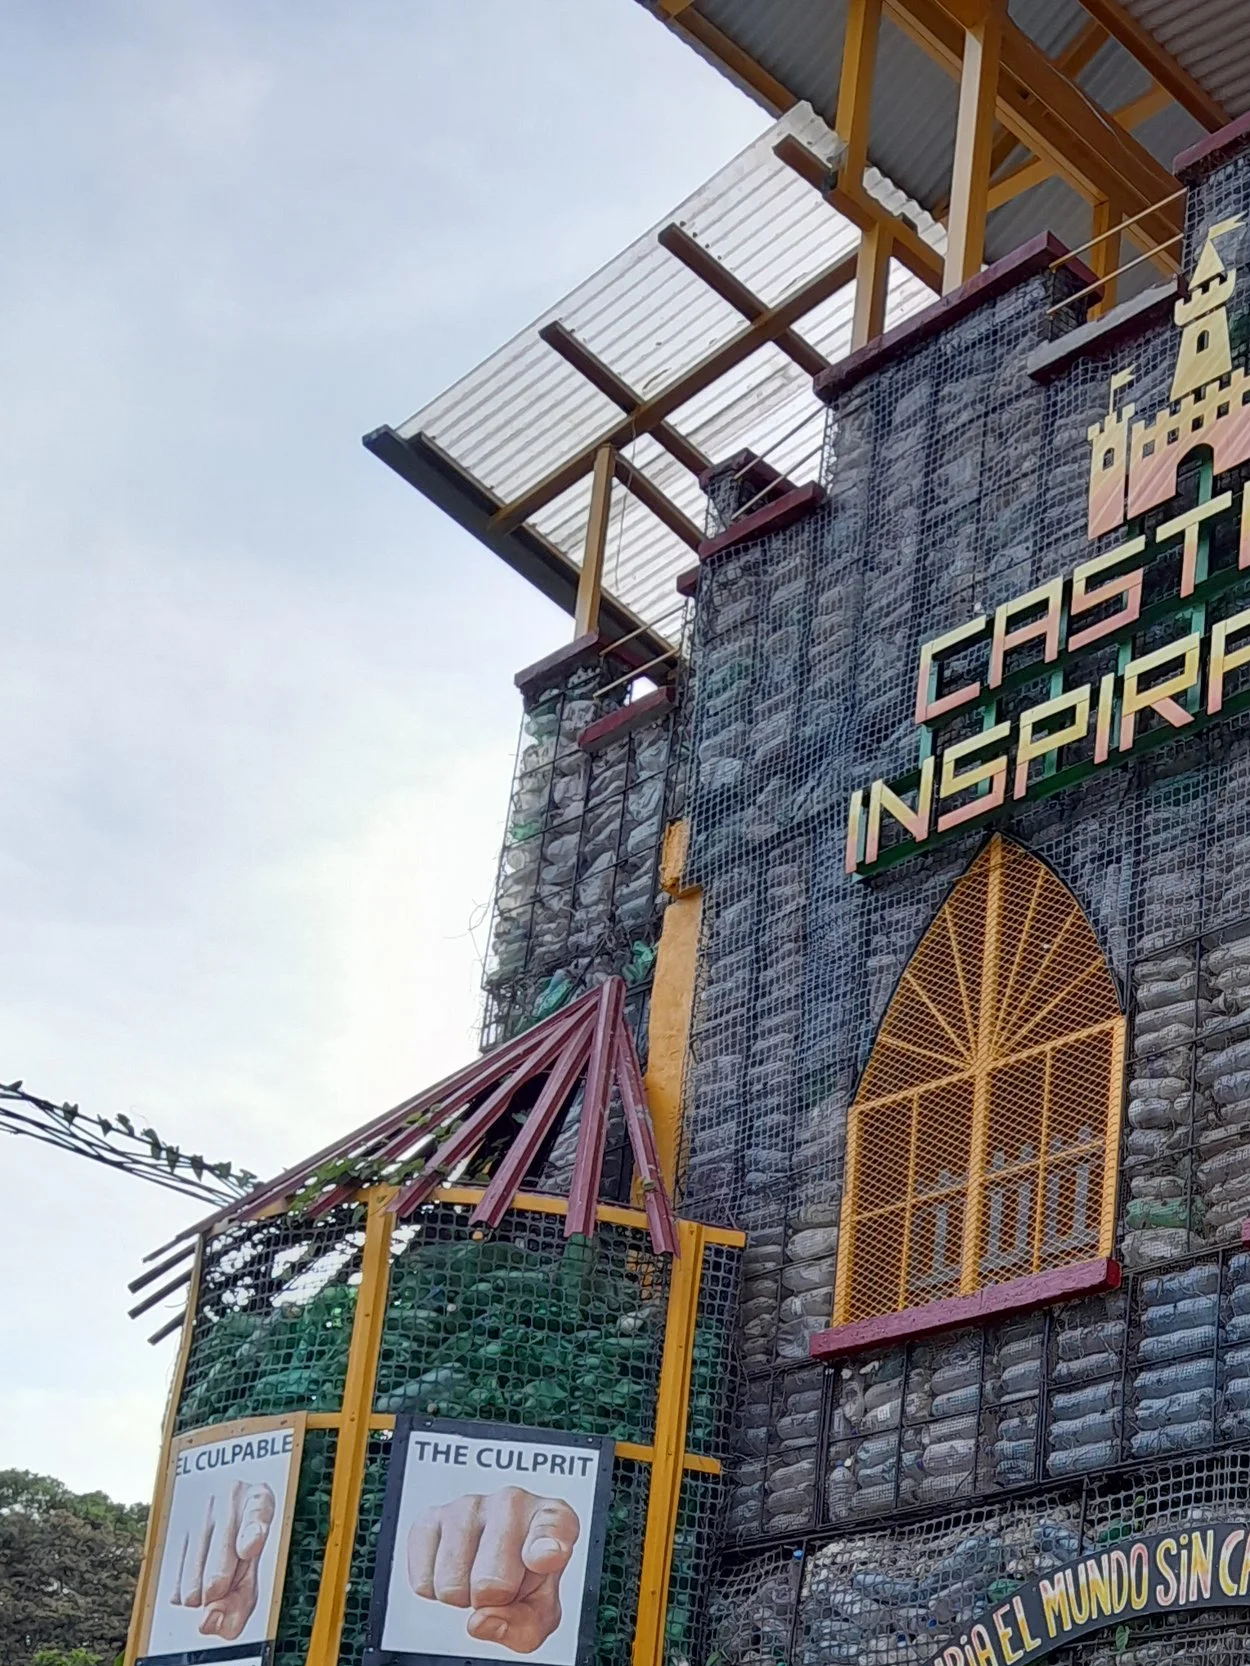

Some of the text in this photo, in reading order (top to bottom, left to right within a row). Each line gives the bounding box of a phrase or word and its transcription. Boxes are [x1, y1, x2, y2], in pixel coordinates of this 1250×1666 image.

[175, 1433, 293, 1477] EL CULPABLE
[414, 1440, 594, 1478] THE CULPRIT
[993, 1602, 1041, 1666] EL
[1039, 1542, 1149, 1639] MUNDO
